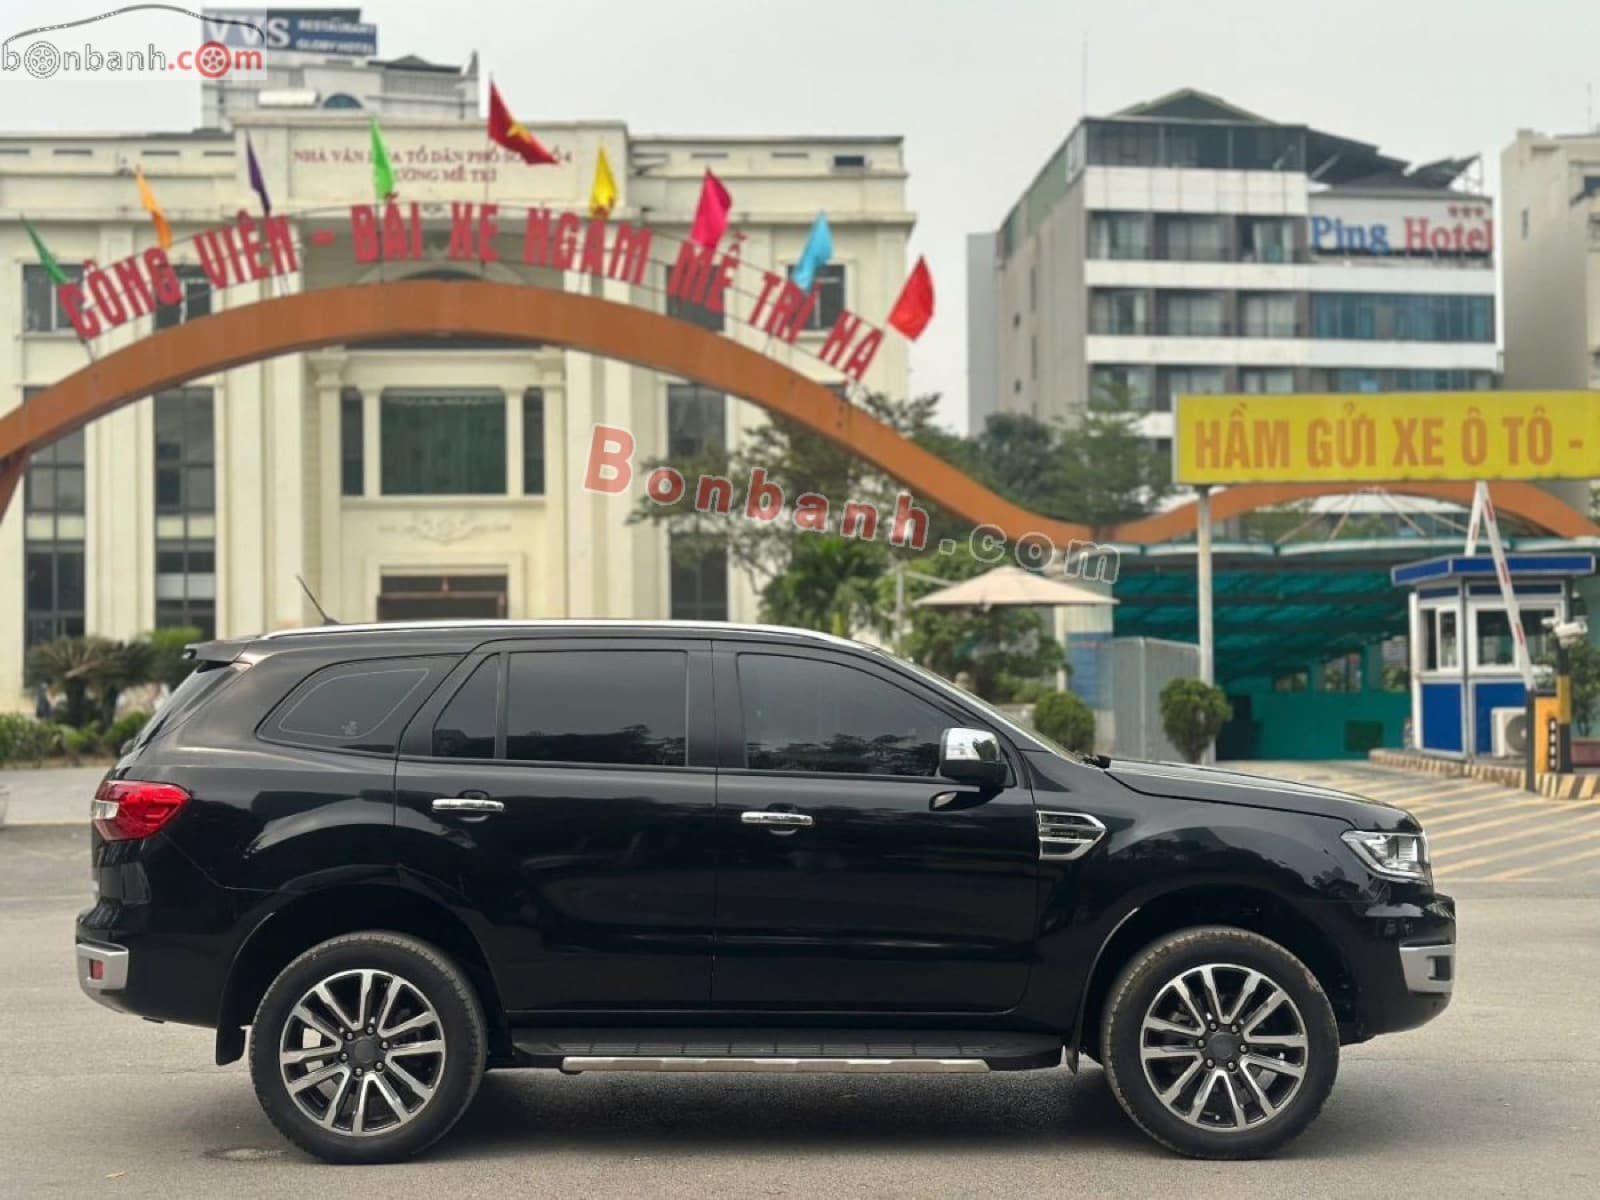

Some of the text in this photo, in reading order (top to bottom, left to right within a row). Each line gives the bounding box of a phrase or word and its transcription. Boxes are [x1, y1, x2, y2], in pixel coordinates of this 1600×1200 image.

[1311, 216, 1493, 255] Ping Hotel
[58, 259, 182, 340] CÔNG
[193, 209, 298, 289] VIÊN
[450, 201, 499, 262] XE
[1195, 402, 1291, 469] HẦM
[1392, 416, 1446, 468] XE
[1461, 406, 1488, 467] Ô
[1502, 404, 1554, 467] TÔ
